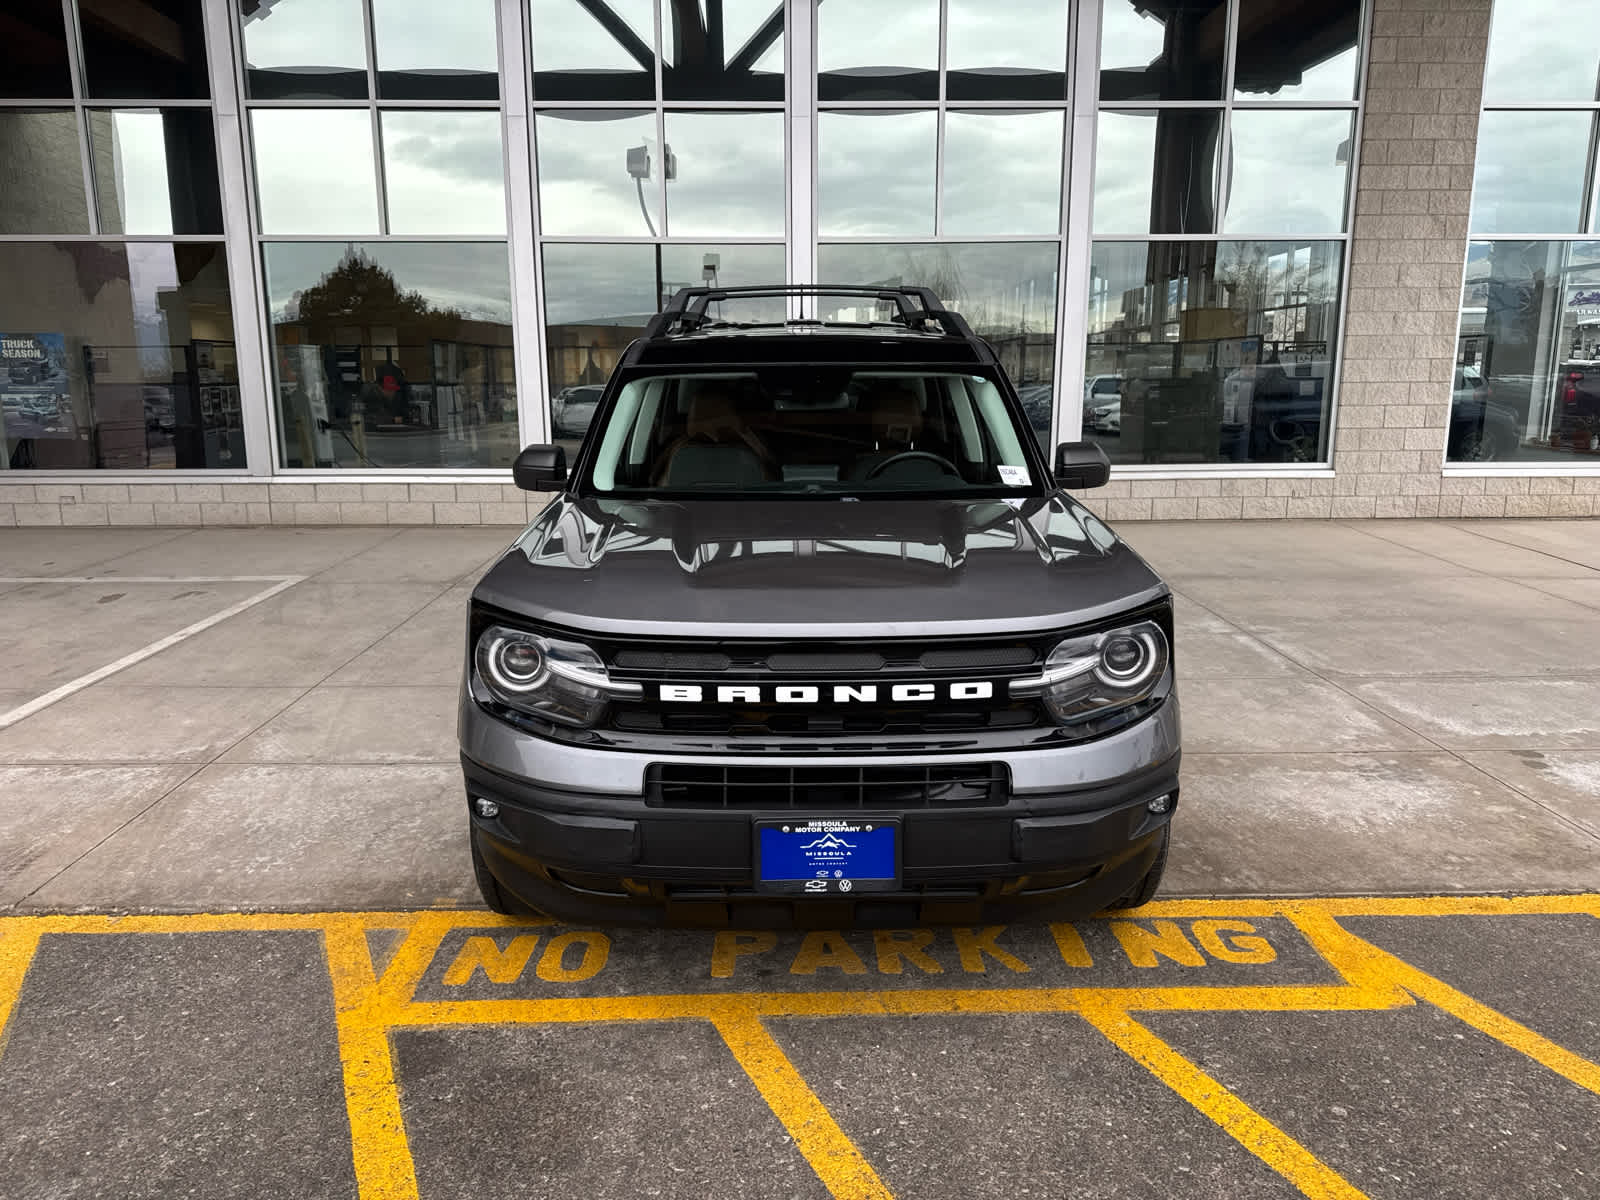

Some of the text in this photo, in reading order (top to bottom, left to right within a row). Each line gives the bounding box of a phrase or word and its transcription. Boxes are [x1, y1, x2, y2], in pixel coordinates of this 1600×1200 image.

[1, 339, 34, 349] TRUCK
[1, 349, 41, 359] SEASON
[659, 681, 993, 703] BRONCO
[442, 919, 1277, 986] NO PARKING
